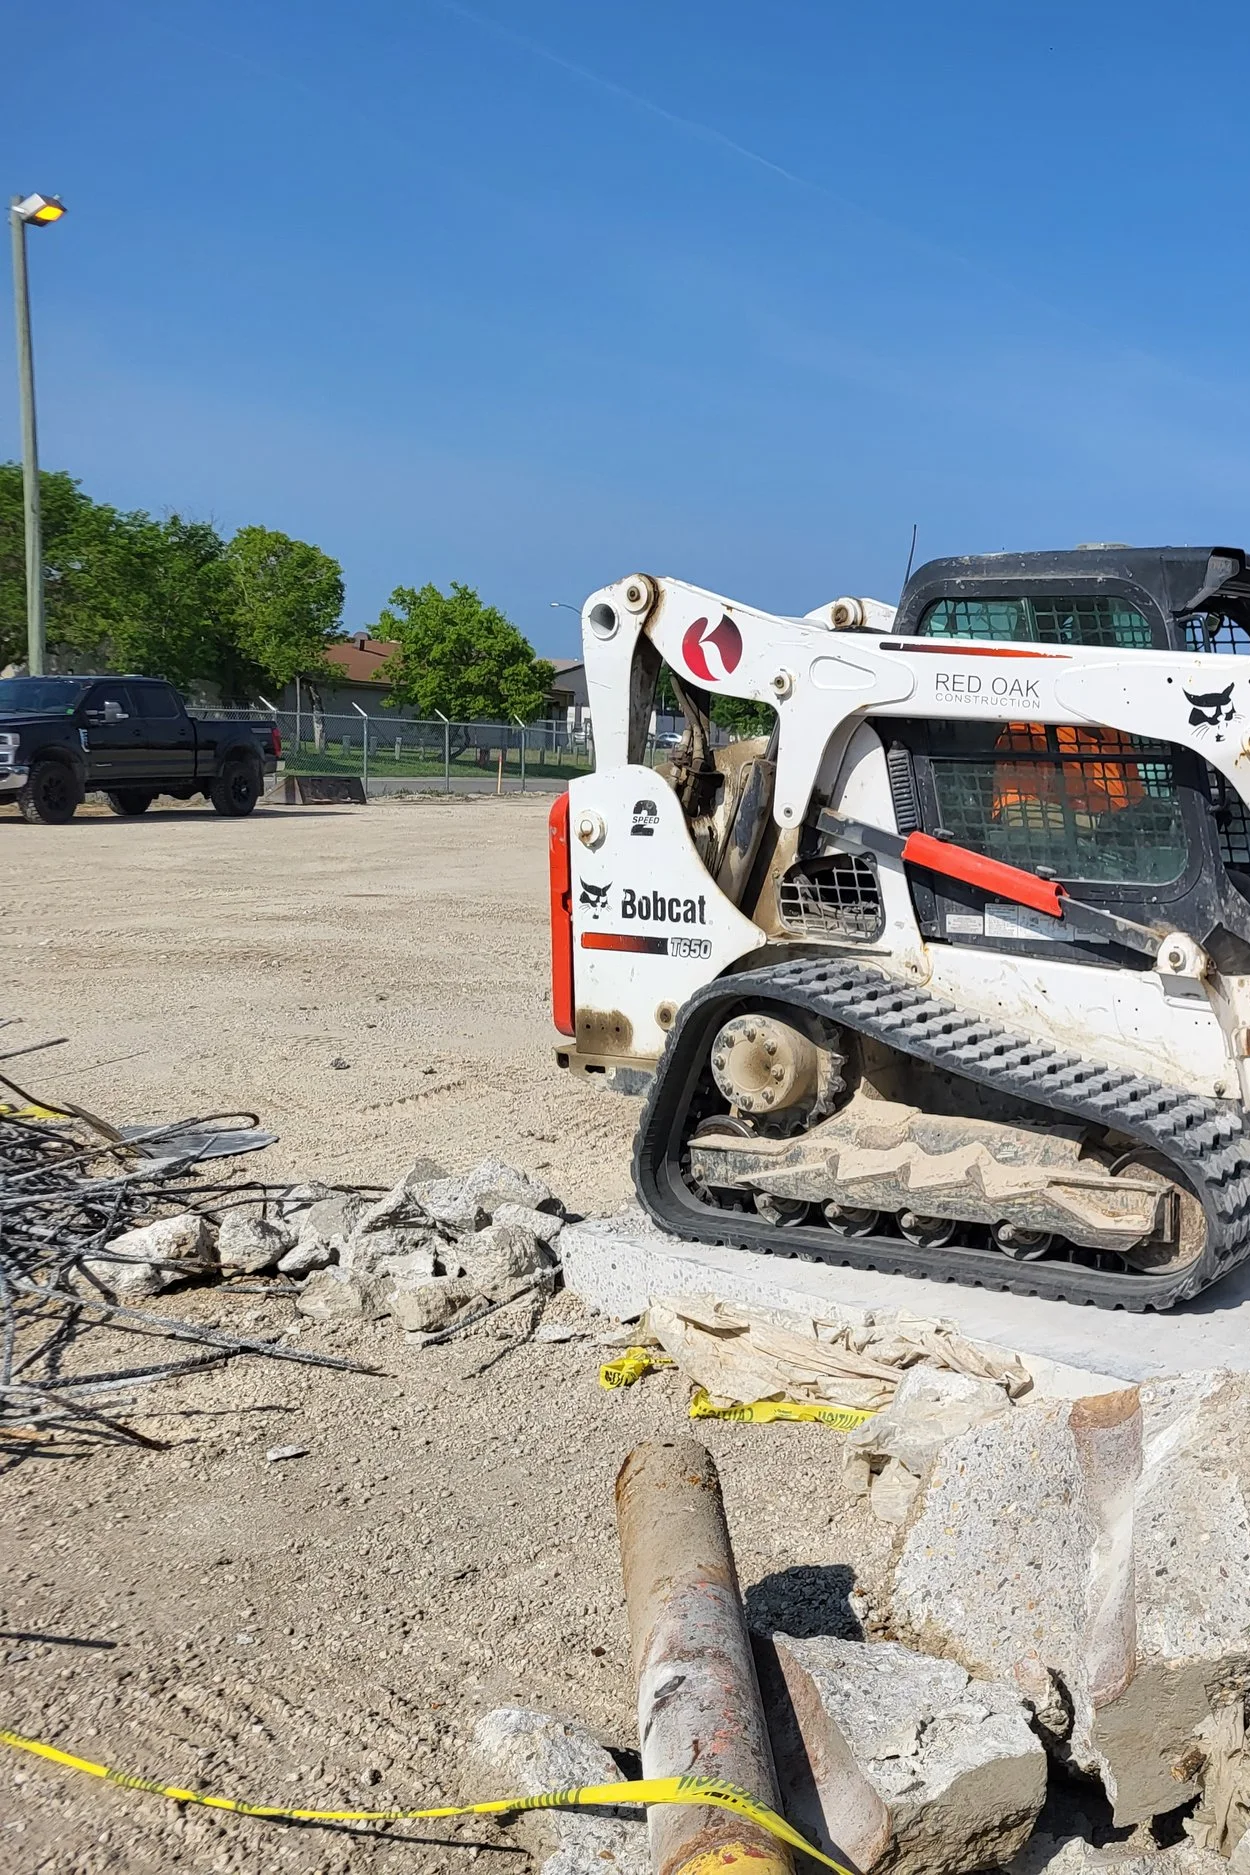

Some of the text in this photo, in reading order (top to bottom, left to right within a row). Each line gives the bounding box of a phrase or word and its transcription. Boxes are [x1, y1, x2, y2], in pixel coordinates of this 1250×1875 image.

[935, 673, 1040, 698] RED OAK
[935, 692, 1041, 709] CONSTRUCTION
[630, 799, 658, 837] 2
[632, 815, 660, 824] SPEED
[621, 888, 706, 925] Bobcat
[670, 937, 712, 959] T650
